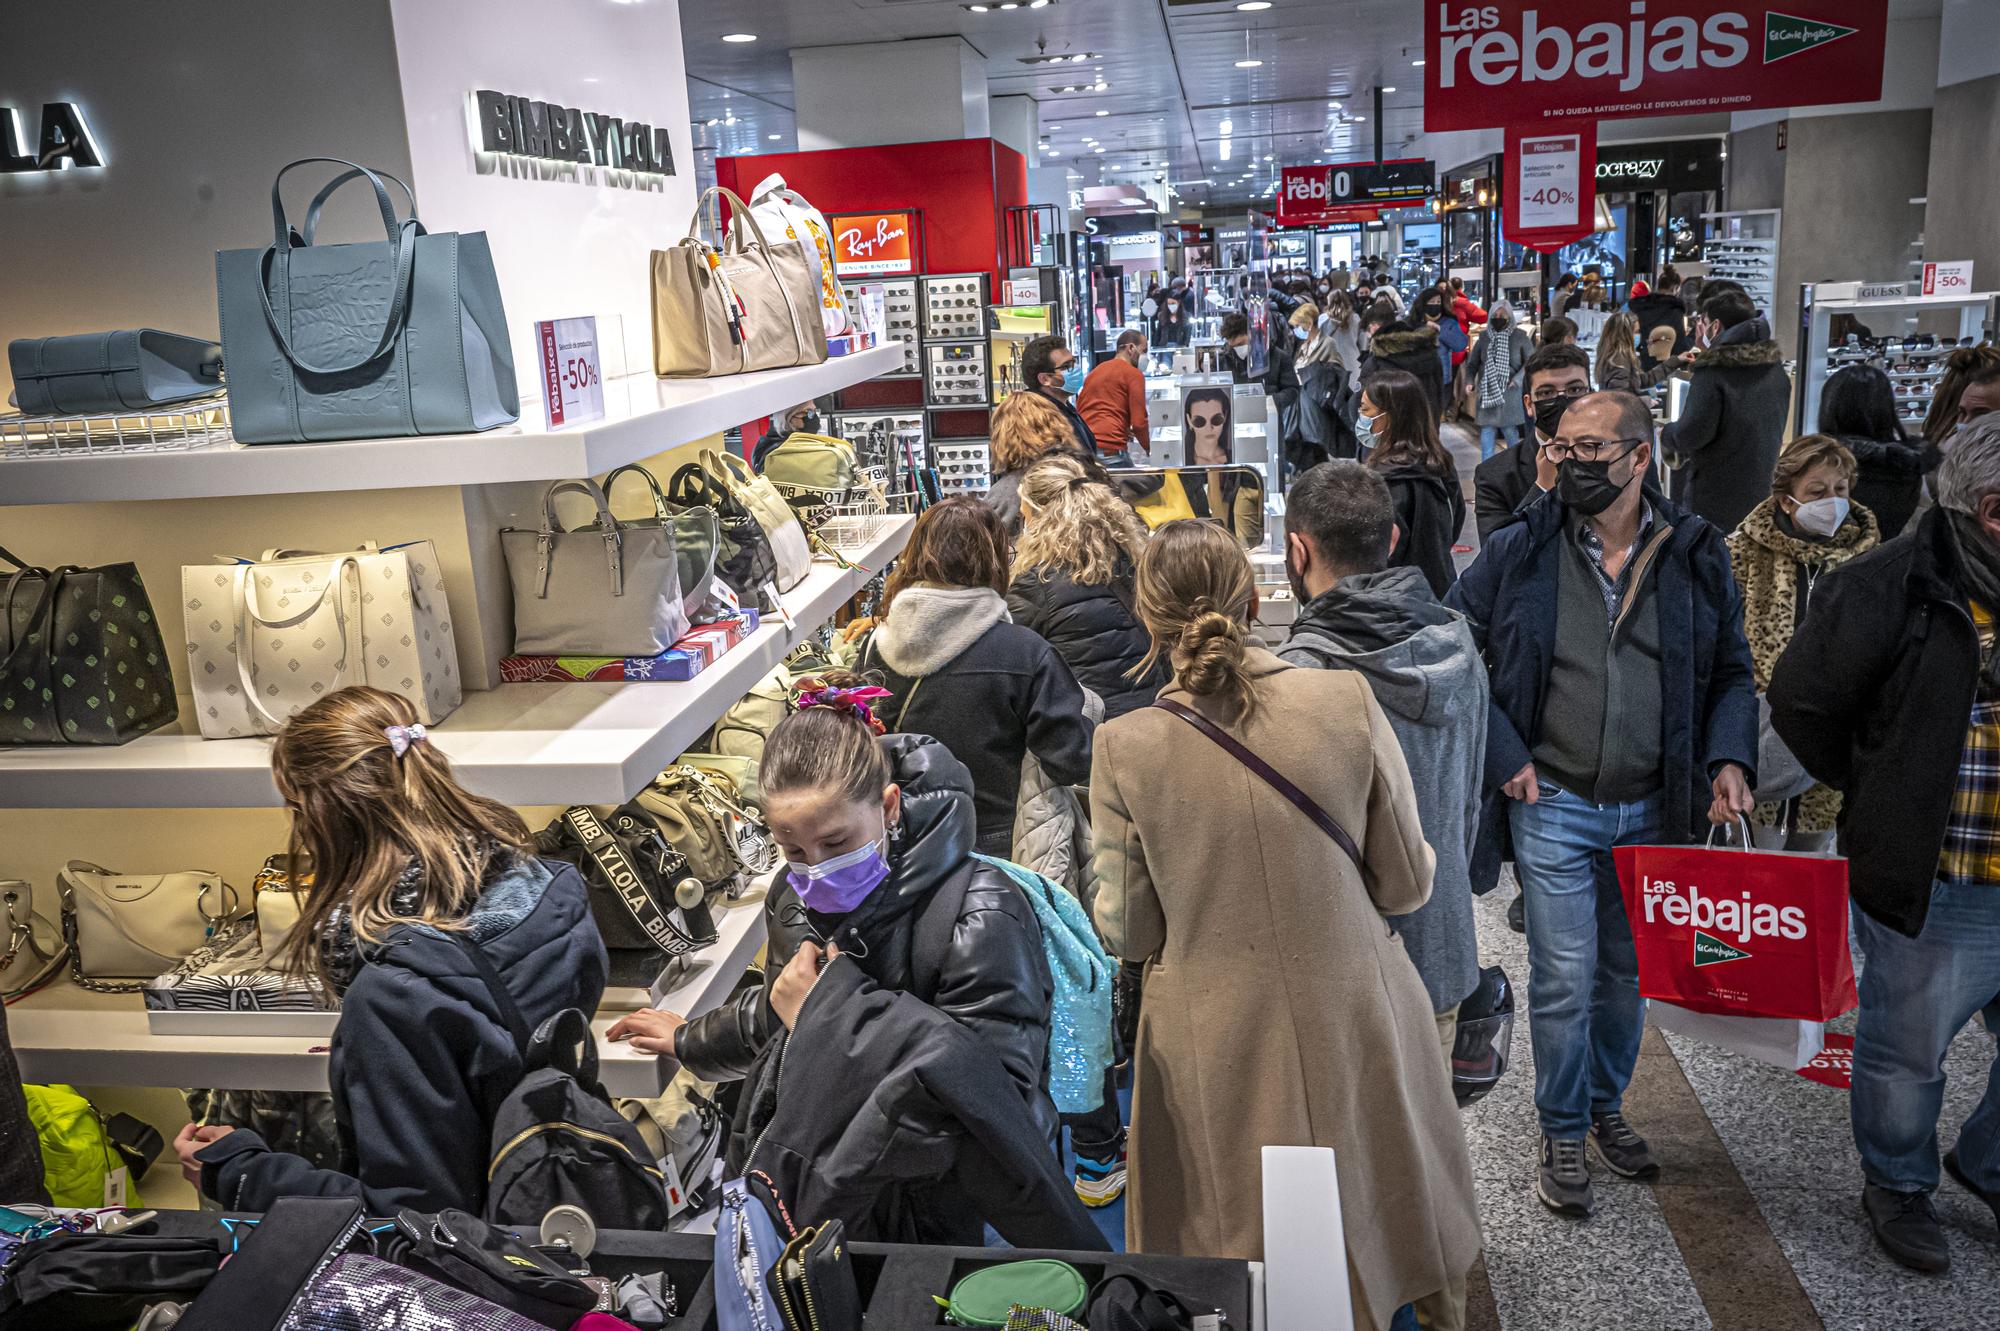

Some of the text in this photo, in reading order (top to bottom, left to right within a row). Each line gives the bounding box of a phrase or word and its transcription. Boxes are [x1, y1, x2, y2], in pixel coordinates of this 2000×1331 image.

[1440, 3, 1500, 32] Las
[1440, 1, 1749, 92] rebajas
[1552, 108, 1564, 116] NO
[1566, 106, 1593, 115] QUEDA
[1594, 103, 1642, 113] SATISFECHO
[1654, 97, 1707, 108] DEVOLVEMOS
[1708, 97, 1720, 105] SU
[1721, 94, 1752, 104] DINERO
[1595, 159, 1664, 178] ocrazy
[1335, 171, 1350, 197] 0
[1523, 187, 1574, 206] -40%
[1862, 286, 1902, 298] GUESS
[562, 357, 598, 390] -50%
[607, 860, 648, 914] LOLA
[1643, 876, 1676, 894] Las
[1643, 886, 1807, 942] rebajas
